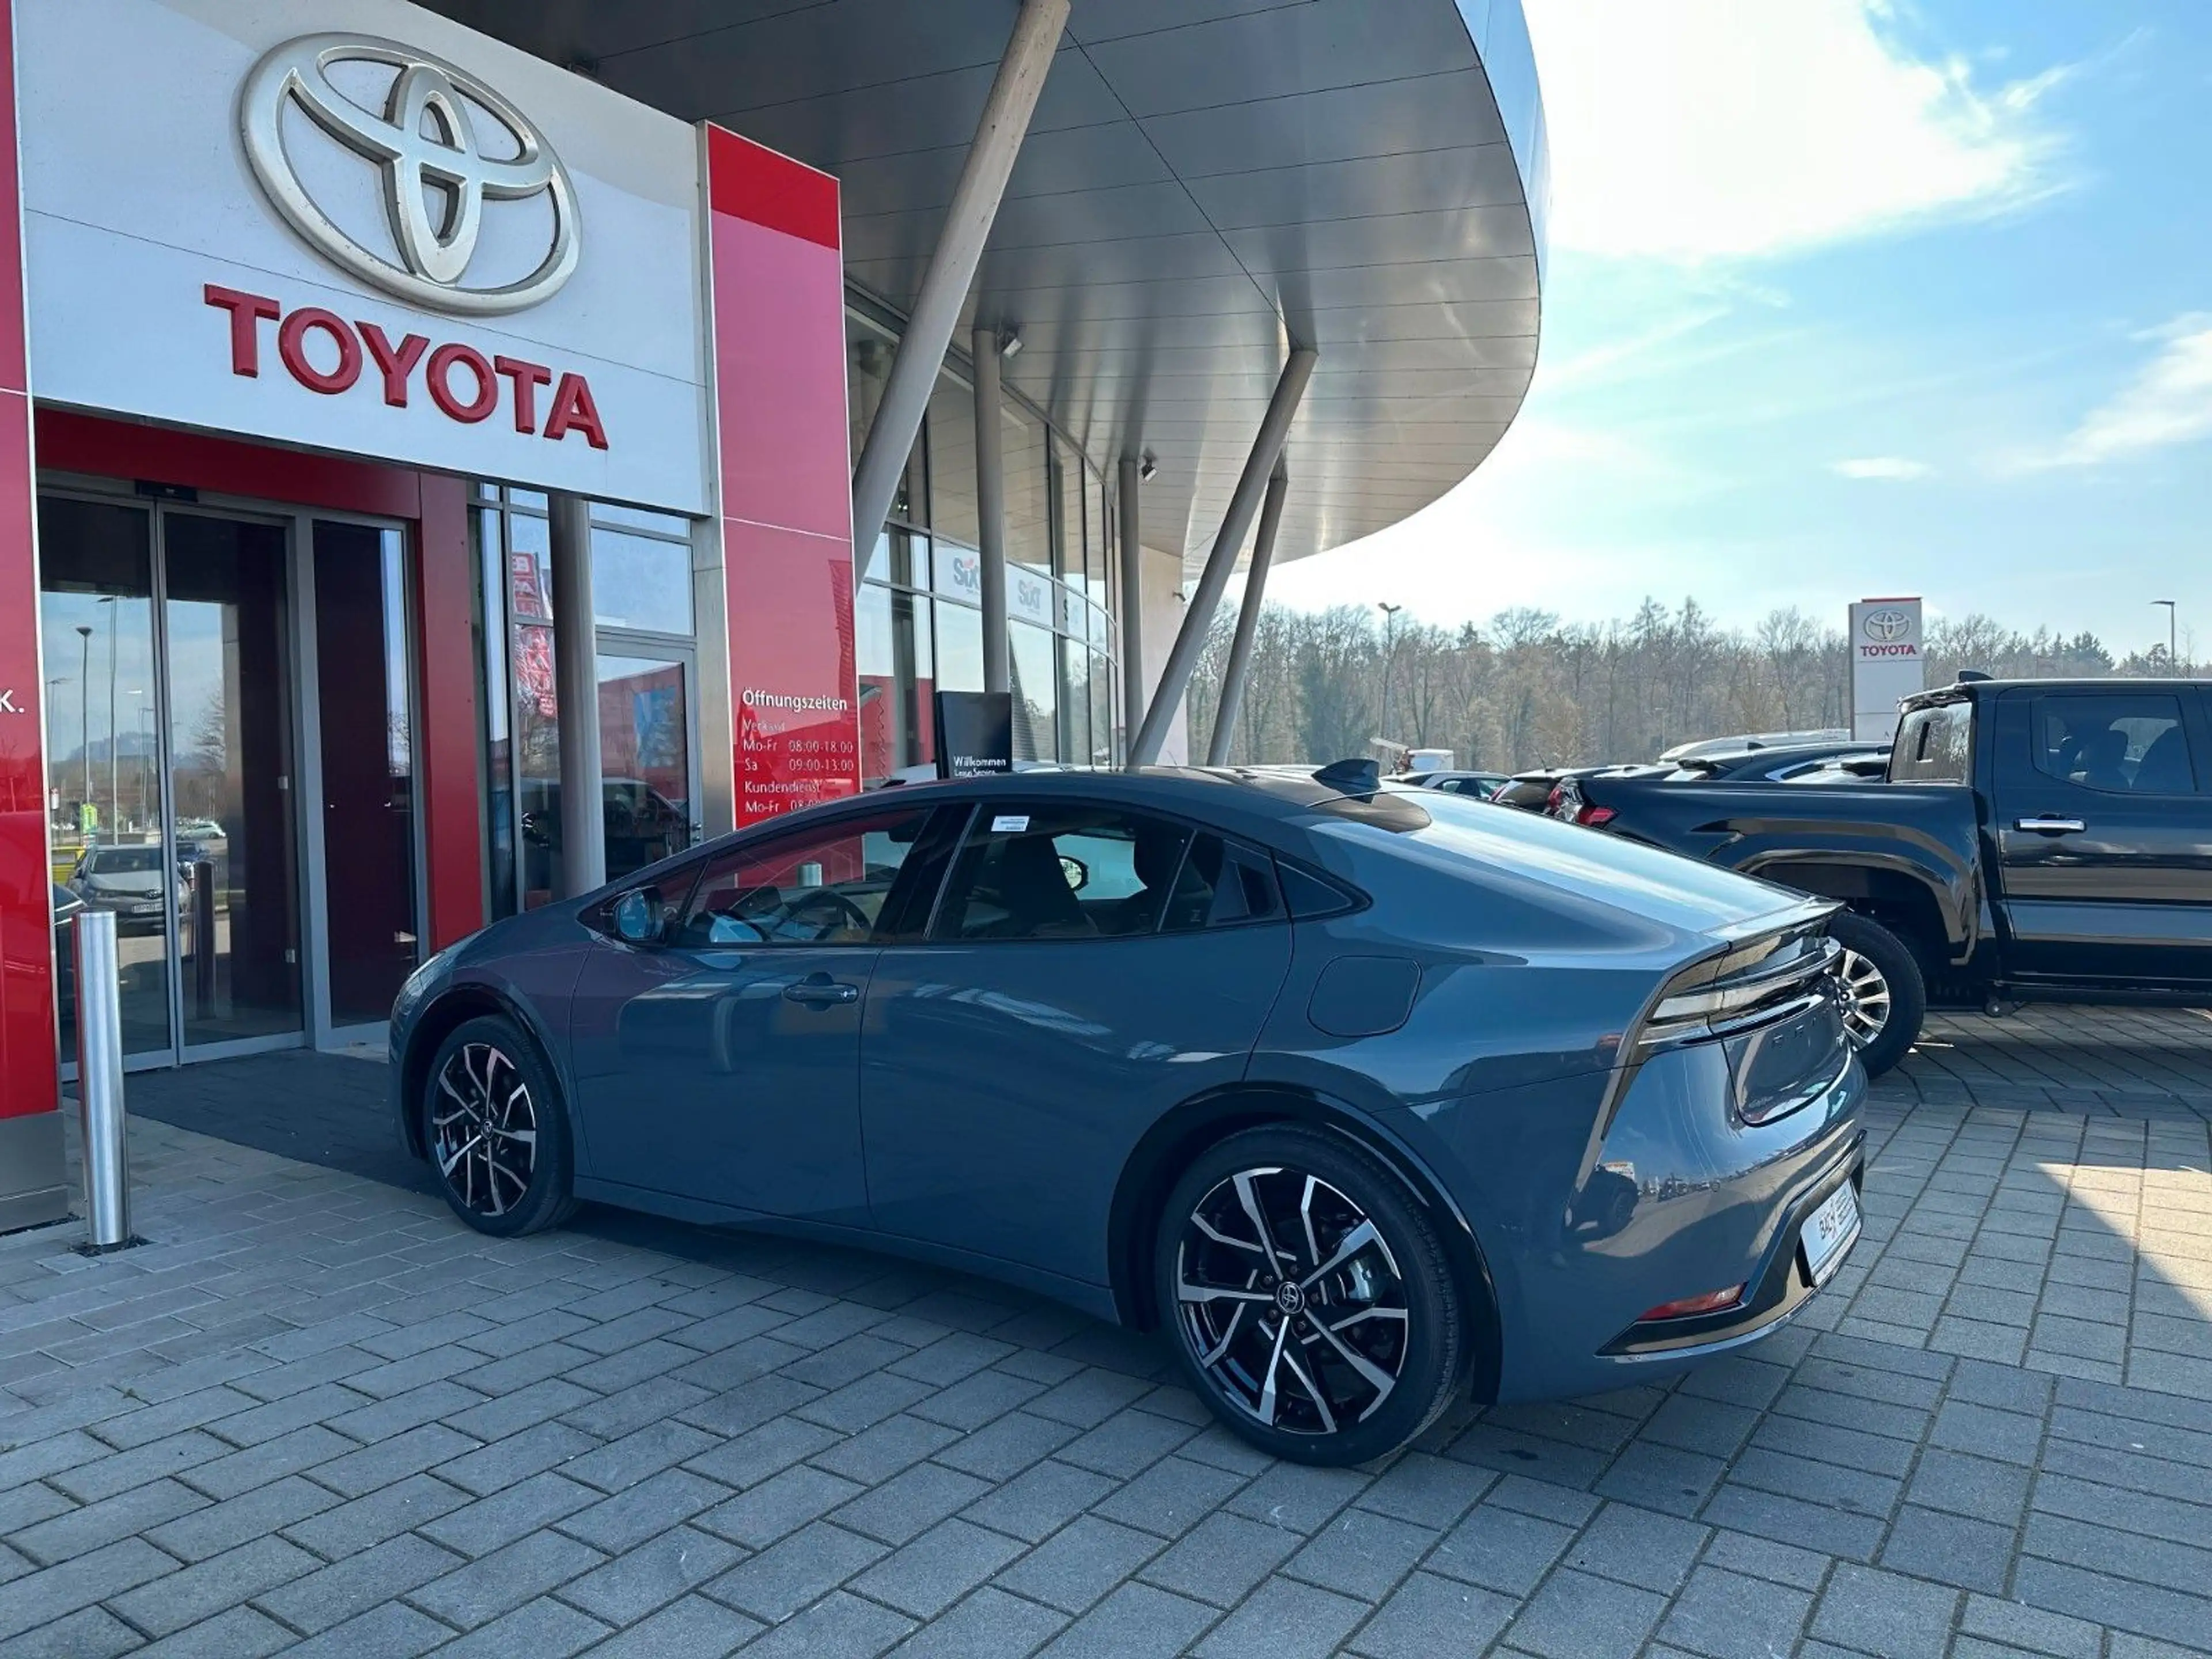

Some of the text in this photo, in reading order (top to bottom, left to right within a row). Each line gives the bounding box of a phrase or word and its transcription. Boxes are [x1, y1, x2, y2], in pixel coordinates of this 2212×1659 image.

[203, 283, 609, 450] TOYOTA
[1860, 645, 1917, 657] TOYOTA
[743, 687, 847, 713] Öffnungszeiten
[744, 738, 777, 752] Mo-Fr
[745, 757, 757, 771] Sa
[954, 755, 1006, 767] Willkommen
[745, 781, 821, 794] Kundendienst
[745, 800, 779, 813] Mo-Fr
